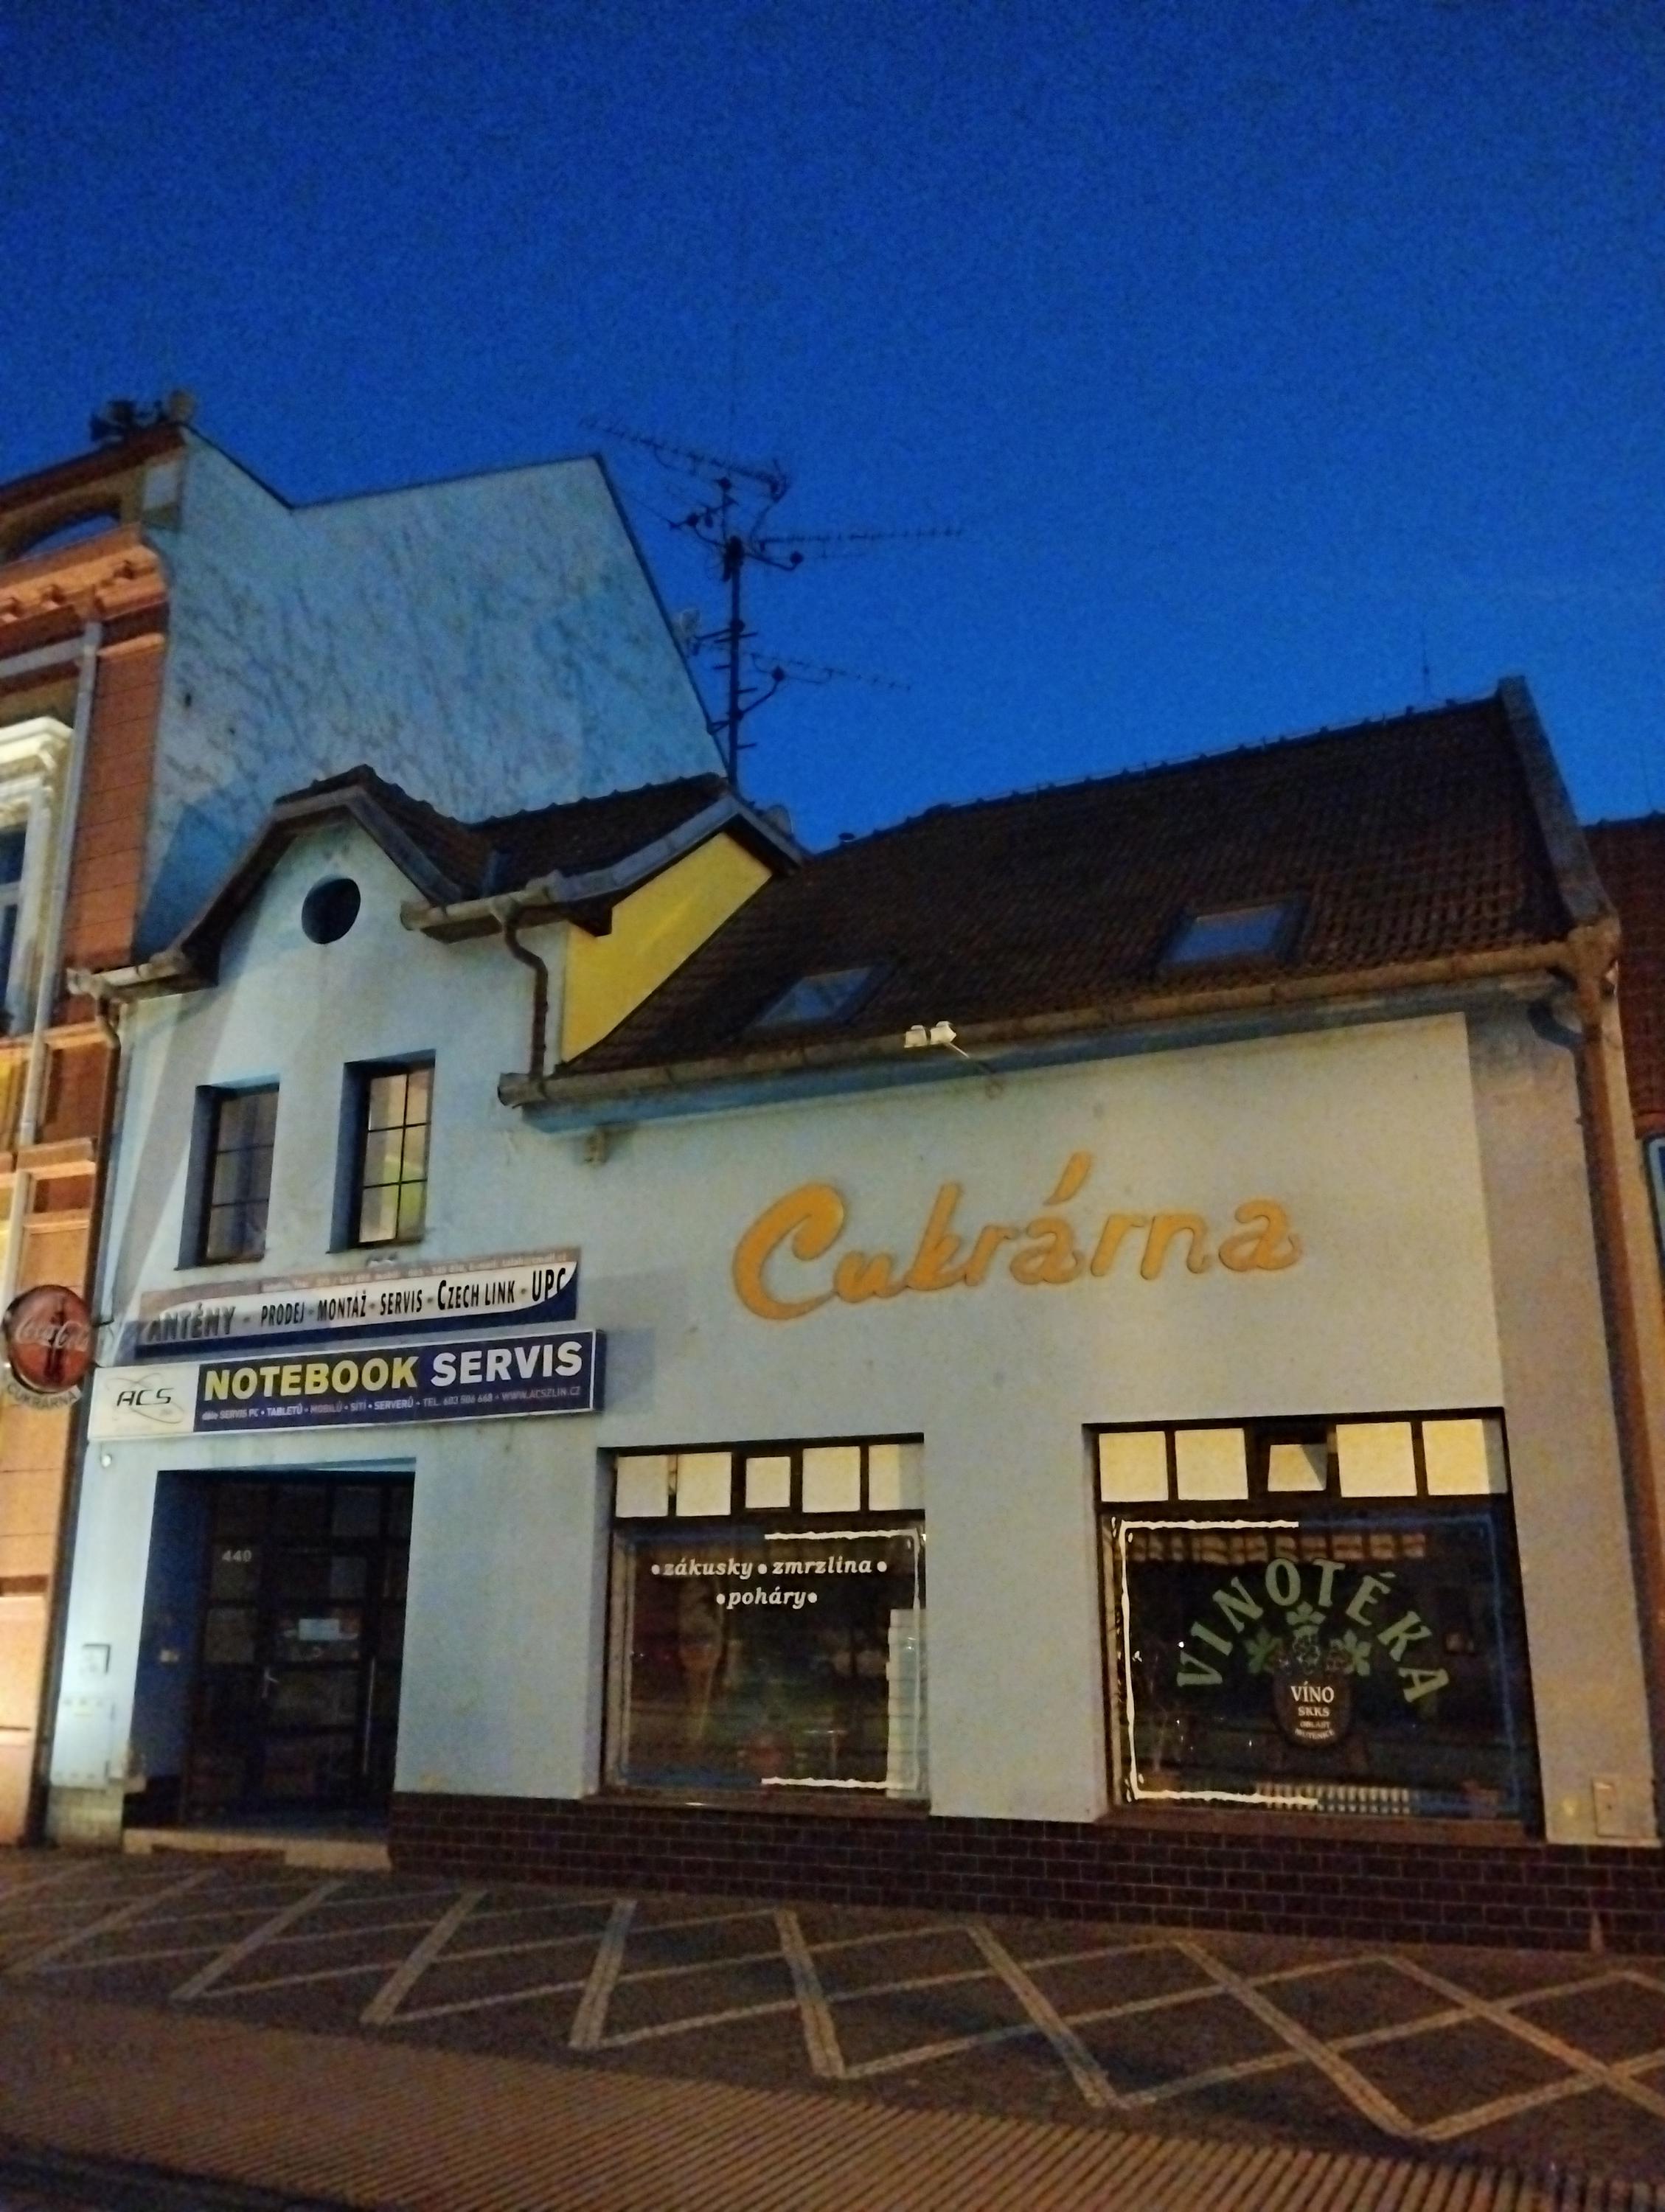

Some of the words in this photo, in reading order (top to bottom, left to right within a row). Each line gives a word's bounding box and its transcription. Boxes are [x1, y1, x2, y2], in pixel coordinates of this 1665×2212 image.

[731, 1150, 1303, 1321] Cukrárna
[148, 1302, 235, 1341] ANTÉNY
[261, 1301, 305, 1326] PRODEJ
[316, 1289, 366, 1321] MONTÁŽ
[380, 1290, 422, 1315] SERVIS
[484, 1280, 515, 1306] LINK
[532, 1267, 566, 1301] UPC
[204, 1356, 419, 1401] NOTEBOOK
[430, 1341, 583, 1387] SERVIS
[117, 1387, 175, 1406] ACS
[663, 1556, 753, 1579] zákusky
[772, 1556, 872, 1575] zmrzlina
[726, 1586, 808, 1610] poháry
[1176, 1557, 1450, 1703] VINOTÉKA
[1290, 1680, 1335, 1703] VÍNO
